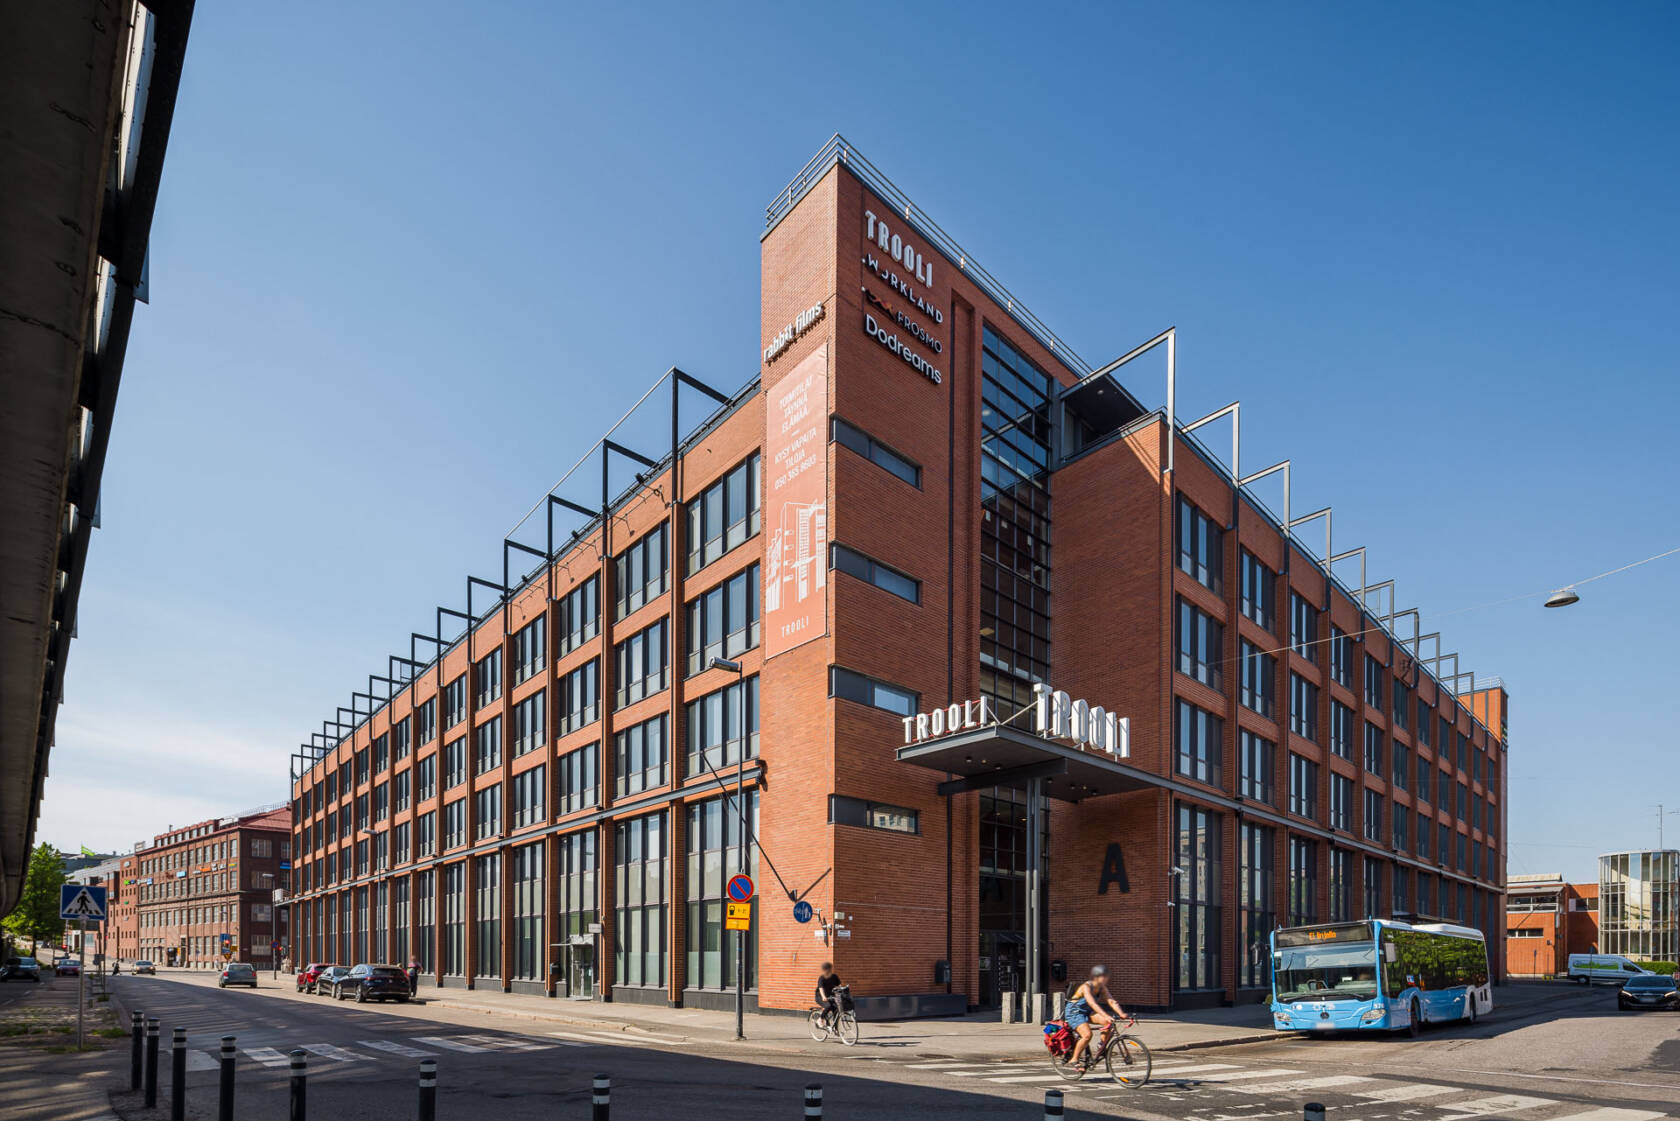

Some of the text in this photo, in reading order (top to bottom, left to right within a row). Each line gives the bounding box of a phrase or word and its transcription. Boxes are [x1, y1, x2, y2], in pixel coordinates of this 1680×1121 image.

[865, 209, 932, 288] TROOLI
[764, 301, 822, 363] rabbit films
[866, 313, 942, 384] Dodreams
[897, 311, 943, 353] FROSMO
[781, 615, 809, 638] TROOLI
[902, 695, 988, 743] TROOLI
[1033, 683, 1130, 758] TROOLI
[1098, 843, 1130, 895] A
